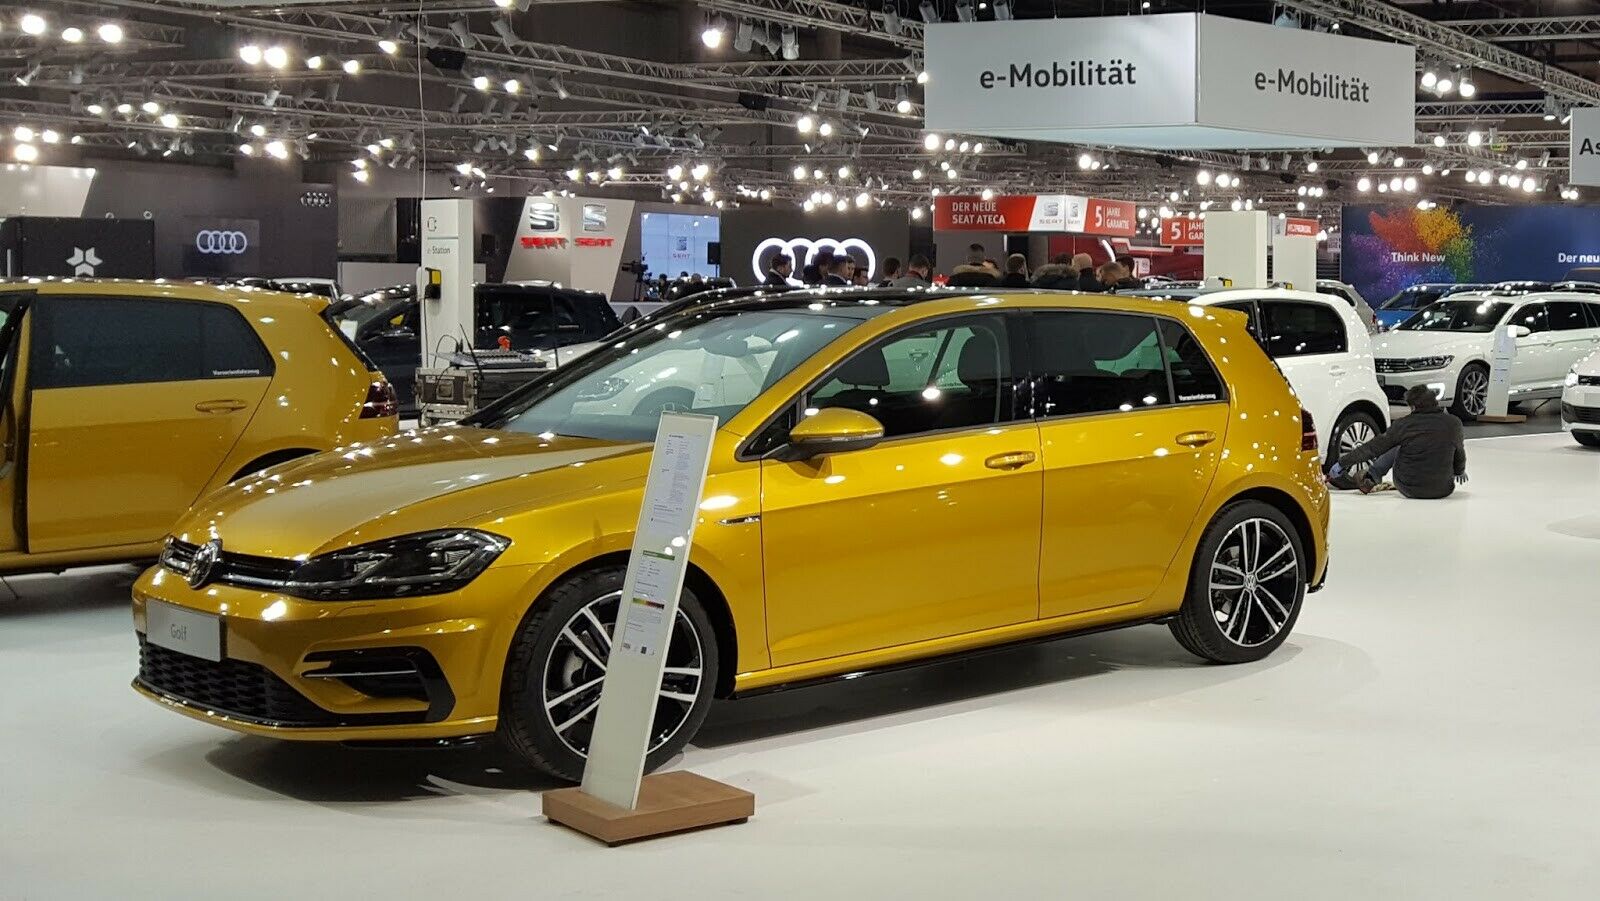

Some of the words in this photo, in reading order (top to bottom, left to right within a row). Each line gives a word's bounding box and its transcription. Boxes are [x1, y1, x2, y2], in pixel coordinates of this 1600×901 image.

[980, 59, 1136, 89] e-Mobilität
[1254, 68, 1369, 103] e-Mobilität
[952, 202, 970, 211] DER
[972, 202, 997, 211] NEUE
[952, 214, 974, 224] SEAT
[976, 214, 1006, 225] ATECA
[1095, 205, 1103, 228] 5
[1171, 222, 1181, 240] 5
[1391, 252, 1420, 262] Think
[1422, 252, 1446, 262] New
[1558, 252, 1578, 263] Der
